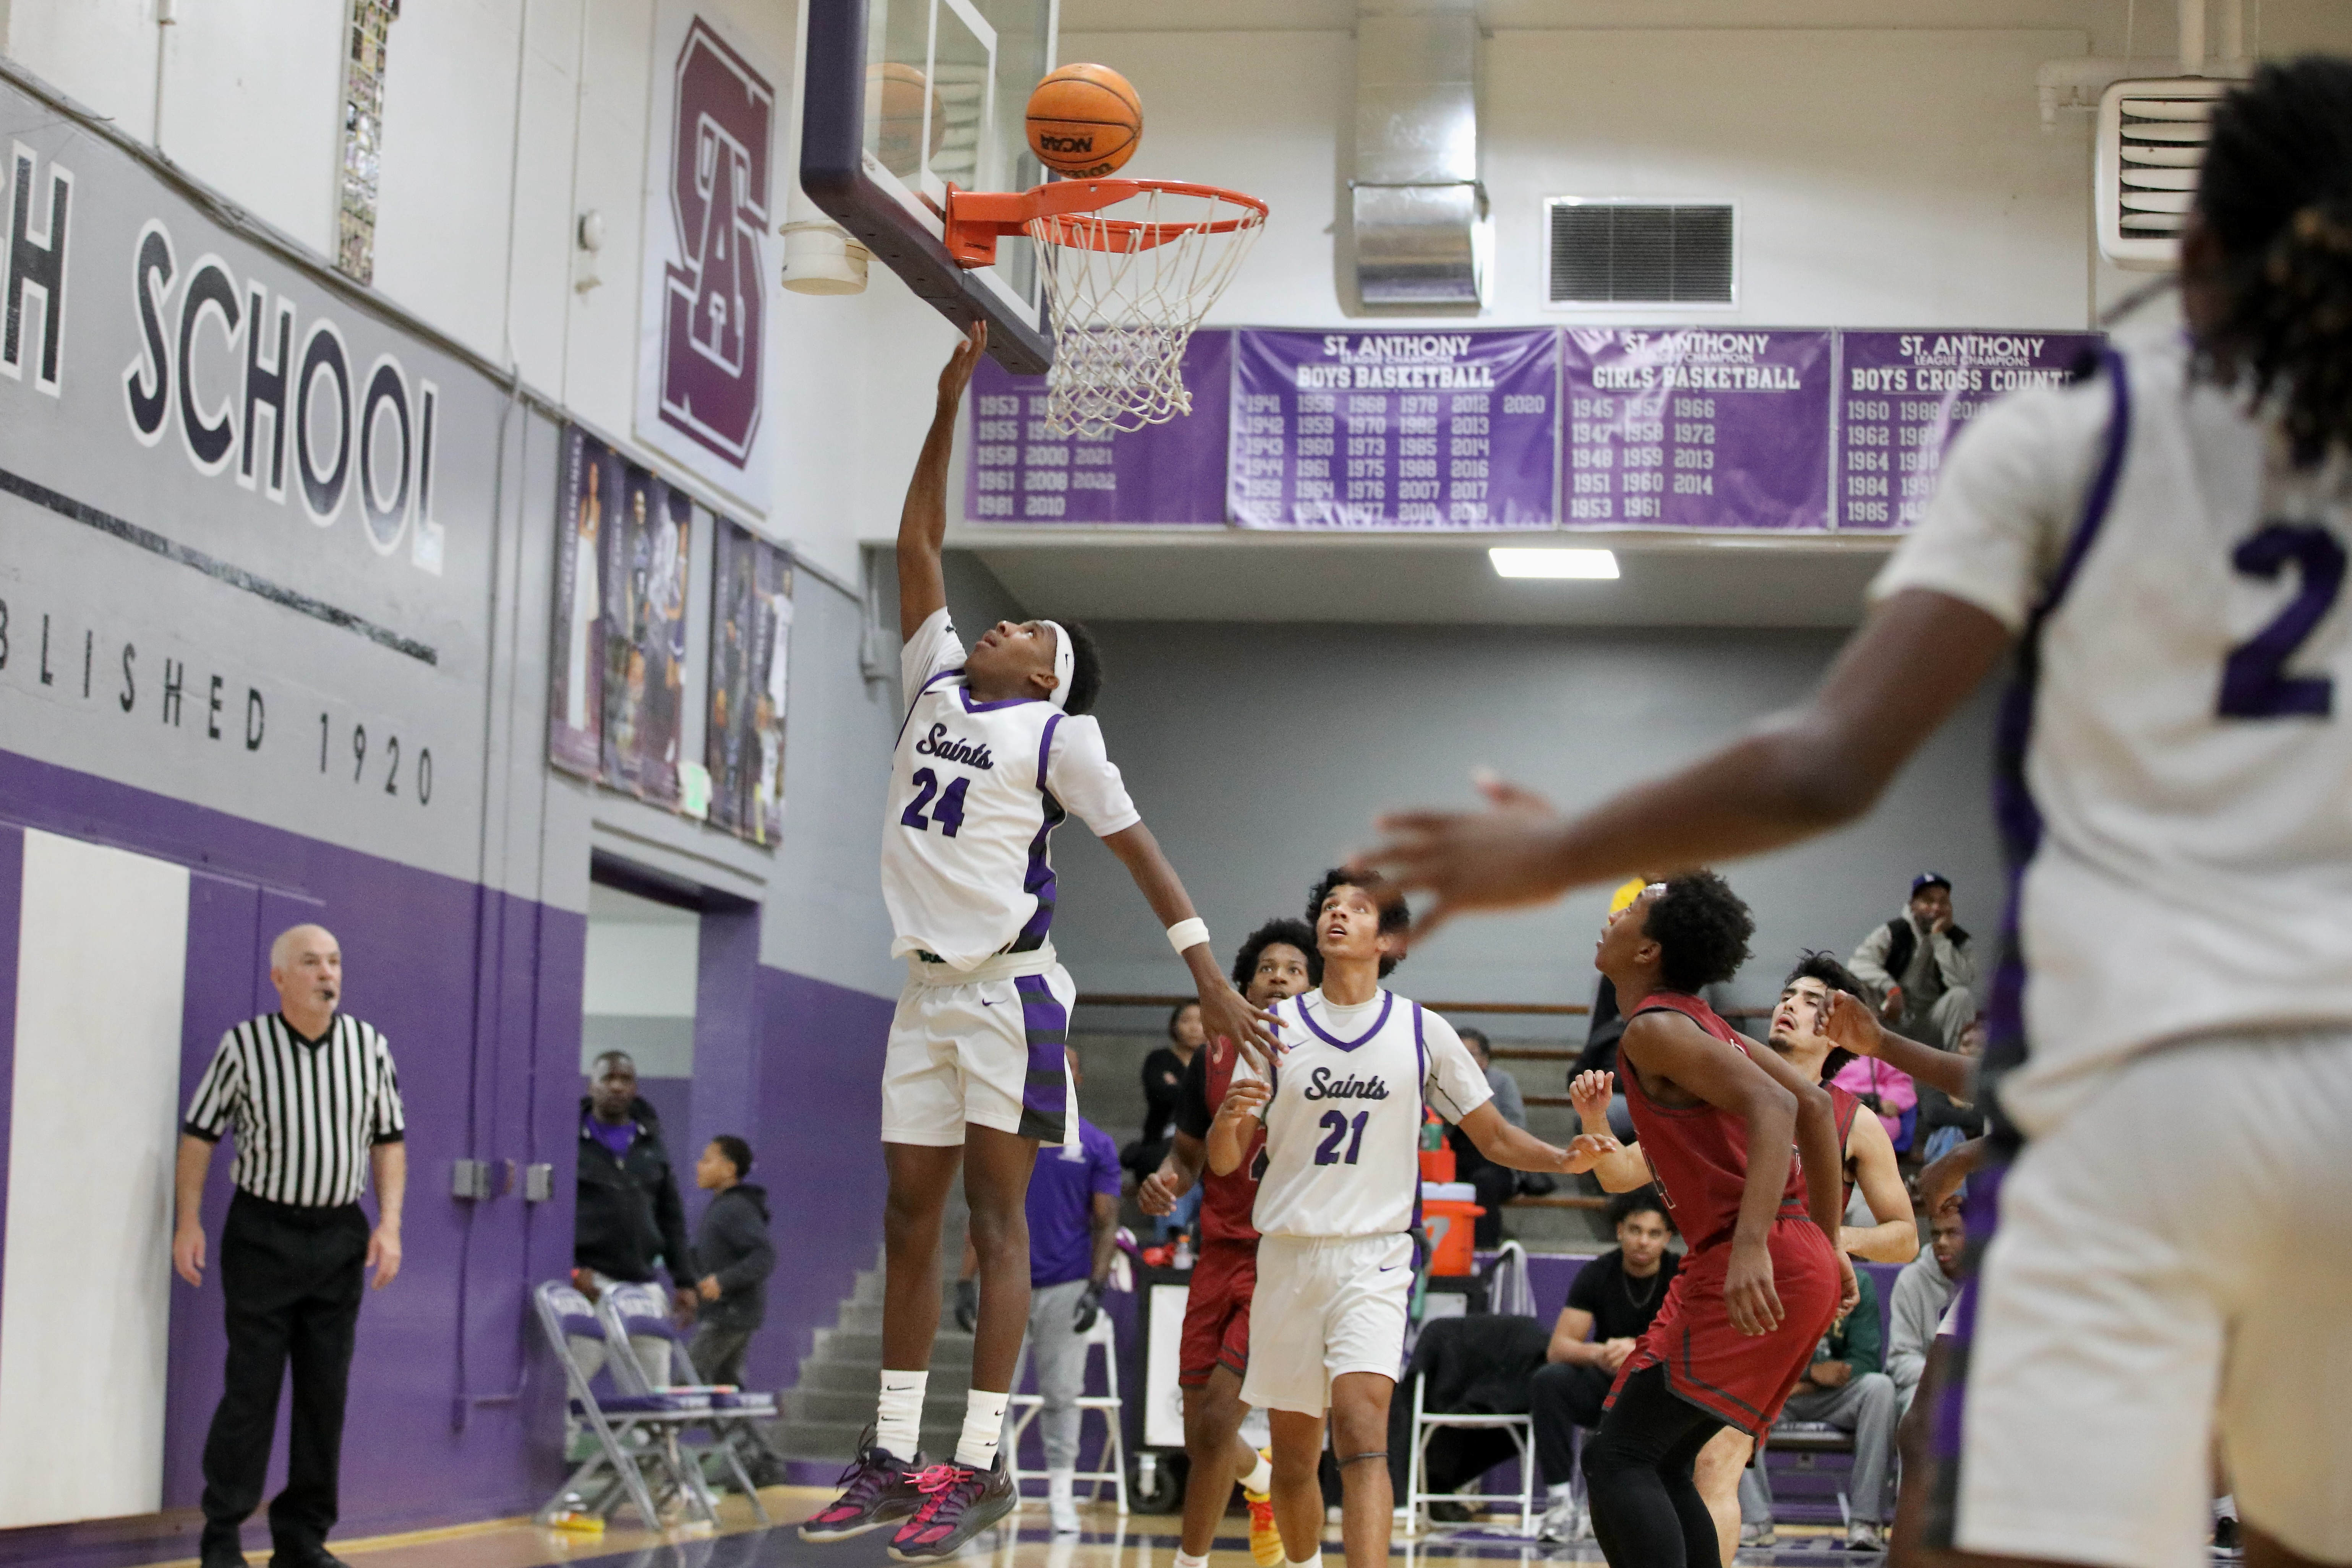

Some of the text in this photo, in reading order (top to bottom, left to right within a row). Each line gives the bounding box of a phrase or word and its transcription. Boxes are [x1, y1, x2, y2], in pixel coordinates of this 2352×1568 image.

[1041, 134, 1093, 153] NCAA
[1324, 335, 1471, 357] ST. ANTHONY
[1658, 333, 1769, 355] ANTHONY
[1900, 335, 2045, 358] ST. ANTHONY
[0, 140, 74, 398] H
[122, 217, 444, 576] SCHOOL
[1914, 355, 2030, 367] LEAGUE CHAMPIONS
[1298, 365, 1495, 389] BOYS BASKETBALL
[1593, 365, 1801, 390] GIRLS BASKETBALL
[1851, 368, 1908, 391] BOYS
[1915, 369, 1982, 392] CROSS
[1451, 394, 1490, 414] 2012
[1503, 394, 1546, 415] 2020
[1572, 397, 1614, 418] 1945
[1674, 397, 1716, 418] 1966
[1847, 401, 1890, 421] 1960
[1347, 415, 1386, 435] 1970
[1451, 415, 1490, 435] 2013
[1571, 422, 1613, 444] 1947
[1674, 423, 1716, 444] 1972
[1847, 425, 1890, 446] 1962
[1347, 437, 1386, 456] 1973
[1450, 437, 1490, 457] 2014
[1347, 459, 1385, 478] 1975
[1571, 447, 1715, 470] 1948 1959 2013
[1847, 451, 1889, 472] 1964
[1398, 480, 1441, 500] 2007
[1450, 480, 1489, 500] 2017
[1573, 472, 1714, 495] 1951 1960 2014
[1847, 476, 1889, 497] 1984
[1571, 496, 1661, 518] 1953 1961
[1847, 501, 1889, 522] 1985
[2216, 523, 2347, 720] 2
[916, 722, 994, 770] Saints
[318, 711, 433, 806] 1920
[900, 767, 971, 838] 24
[1303, 1067, 1389, 1101] Saints
[1314, 1110, 1369, 1166] 21
